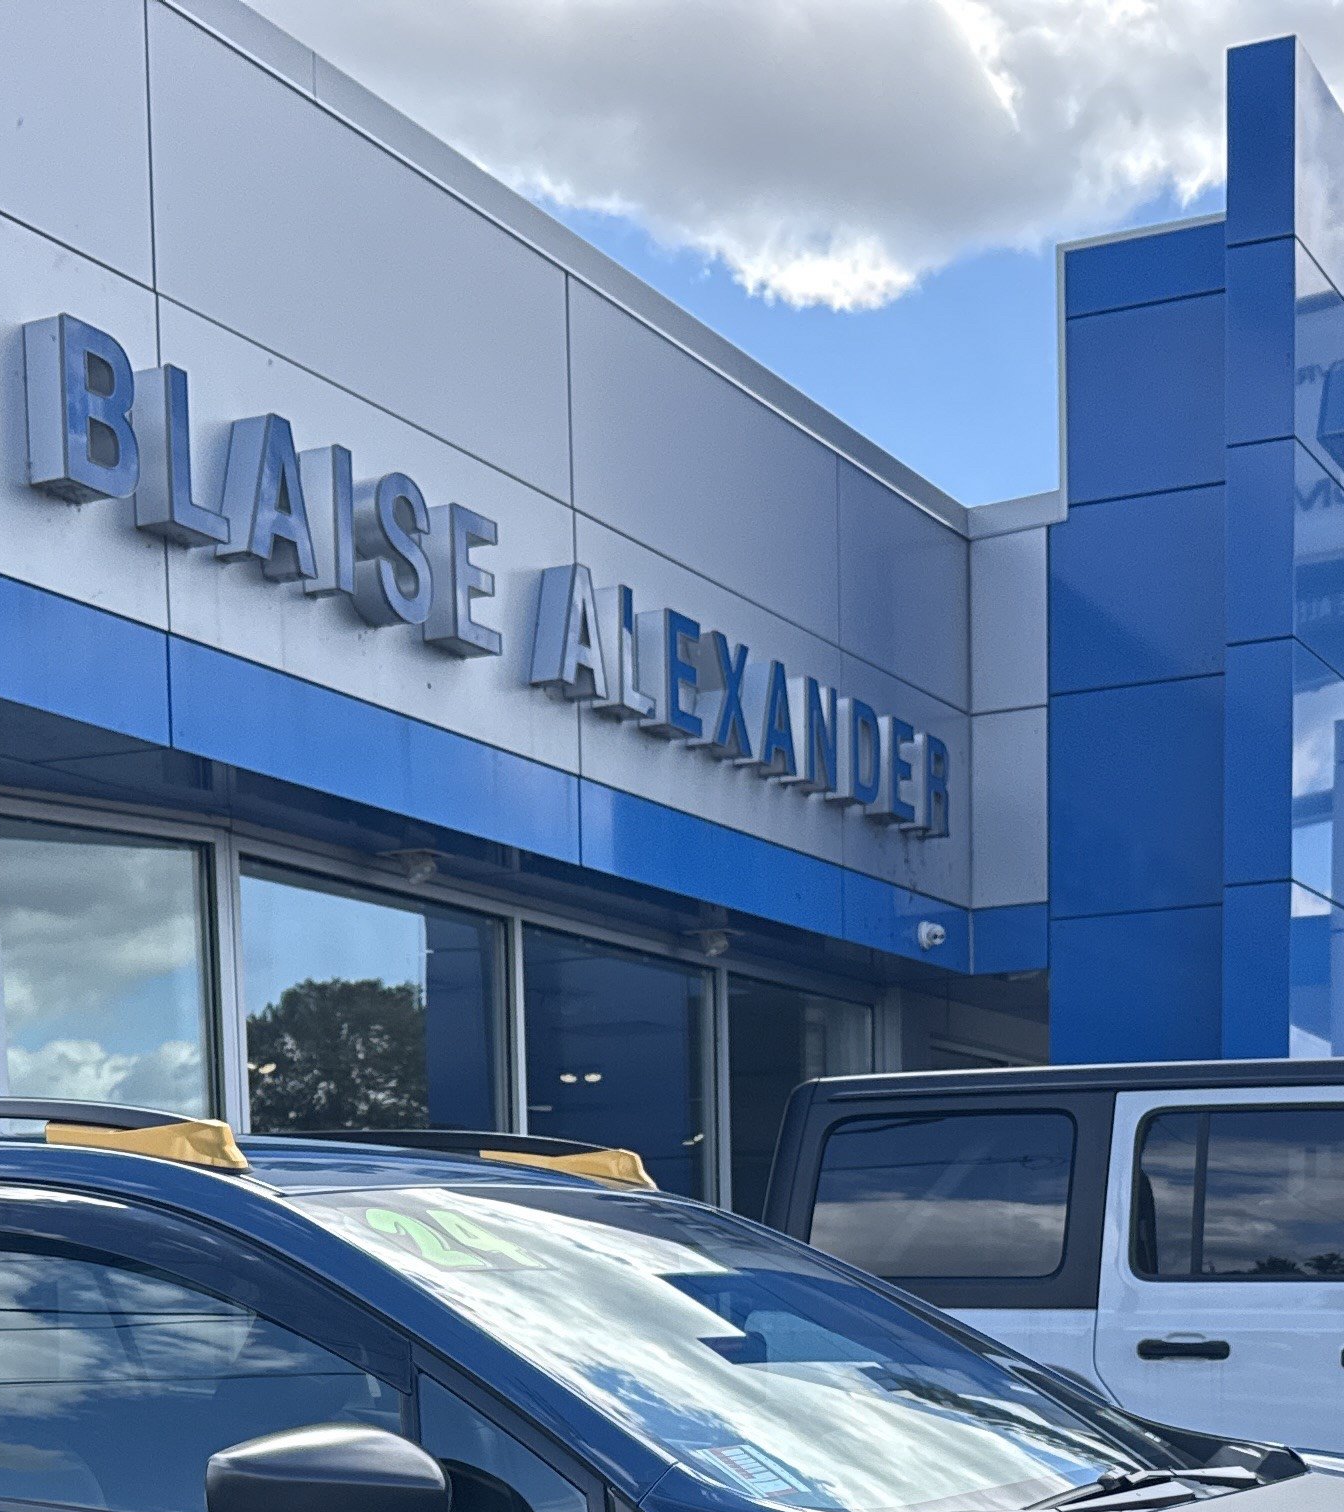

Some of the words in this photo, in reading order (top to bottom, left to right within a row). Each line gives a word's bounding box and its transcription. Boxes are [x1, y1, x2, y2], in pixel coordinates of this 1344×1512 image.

[22, 312, 502, 658] BLAISE
[529, 562, 950, 839] ALEXANDER
[366, 1208, 548, 1269] 24
